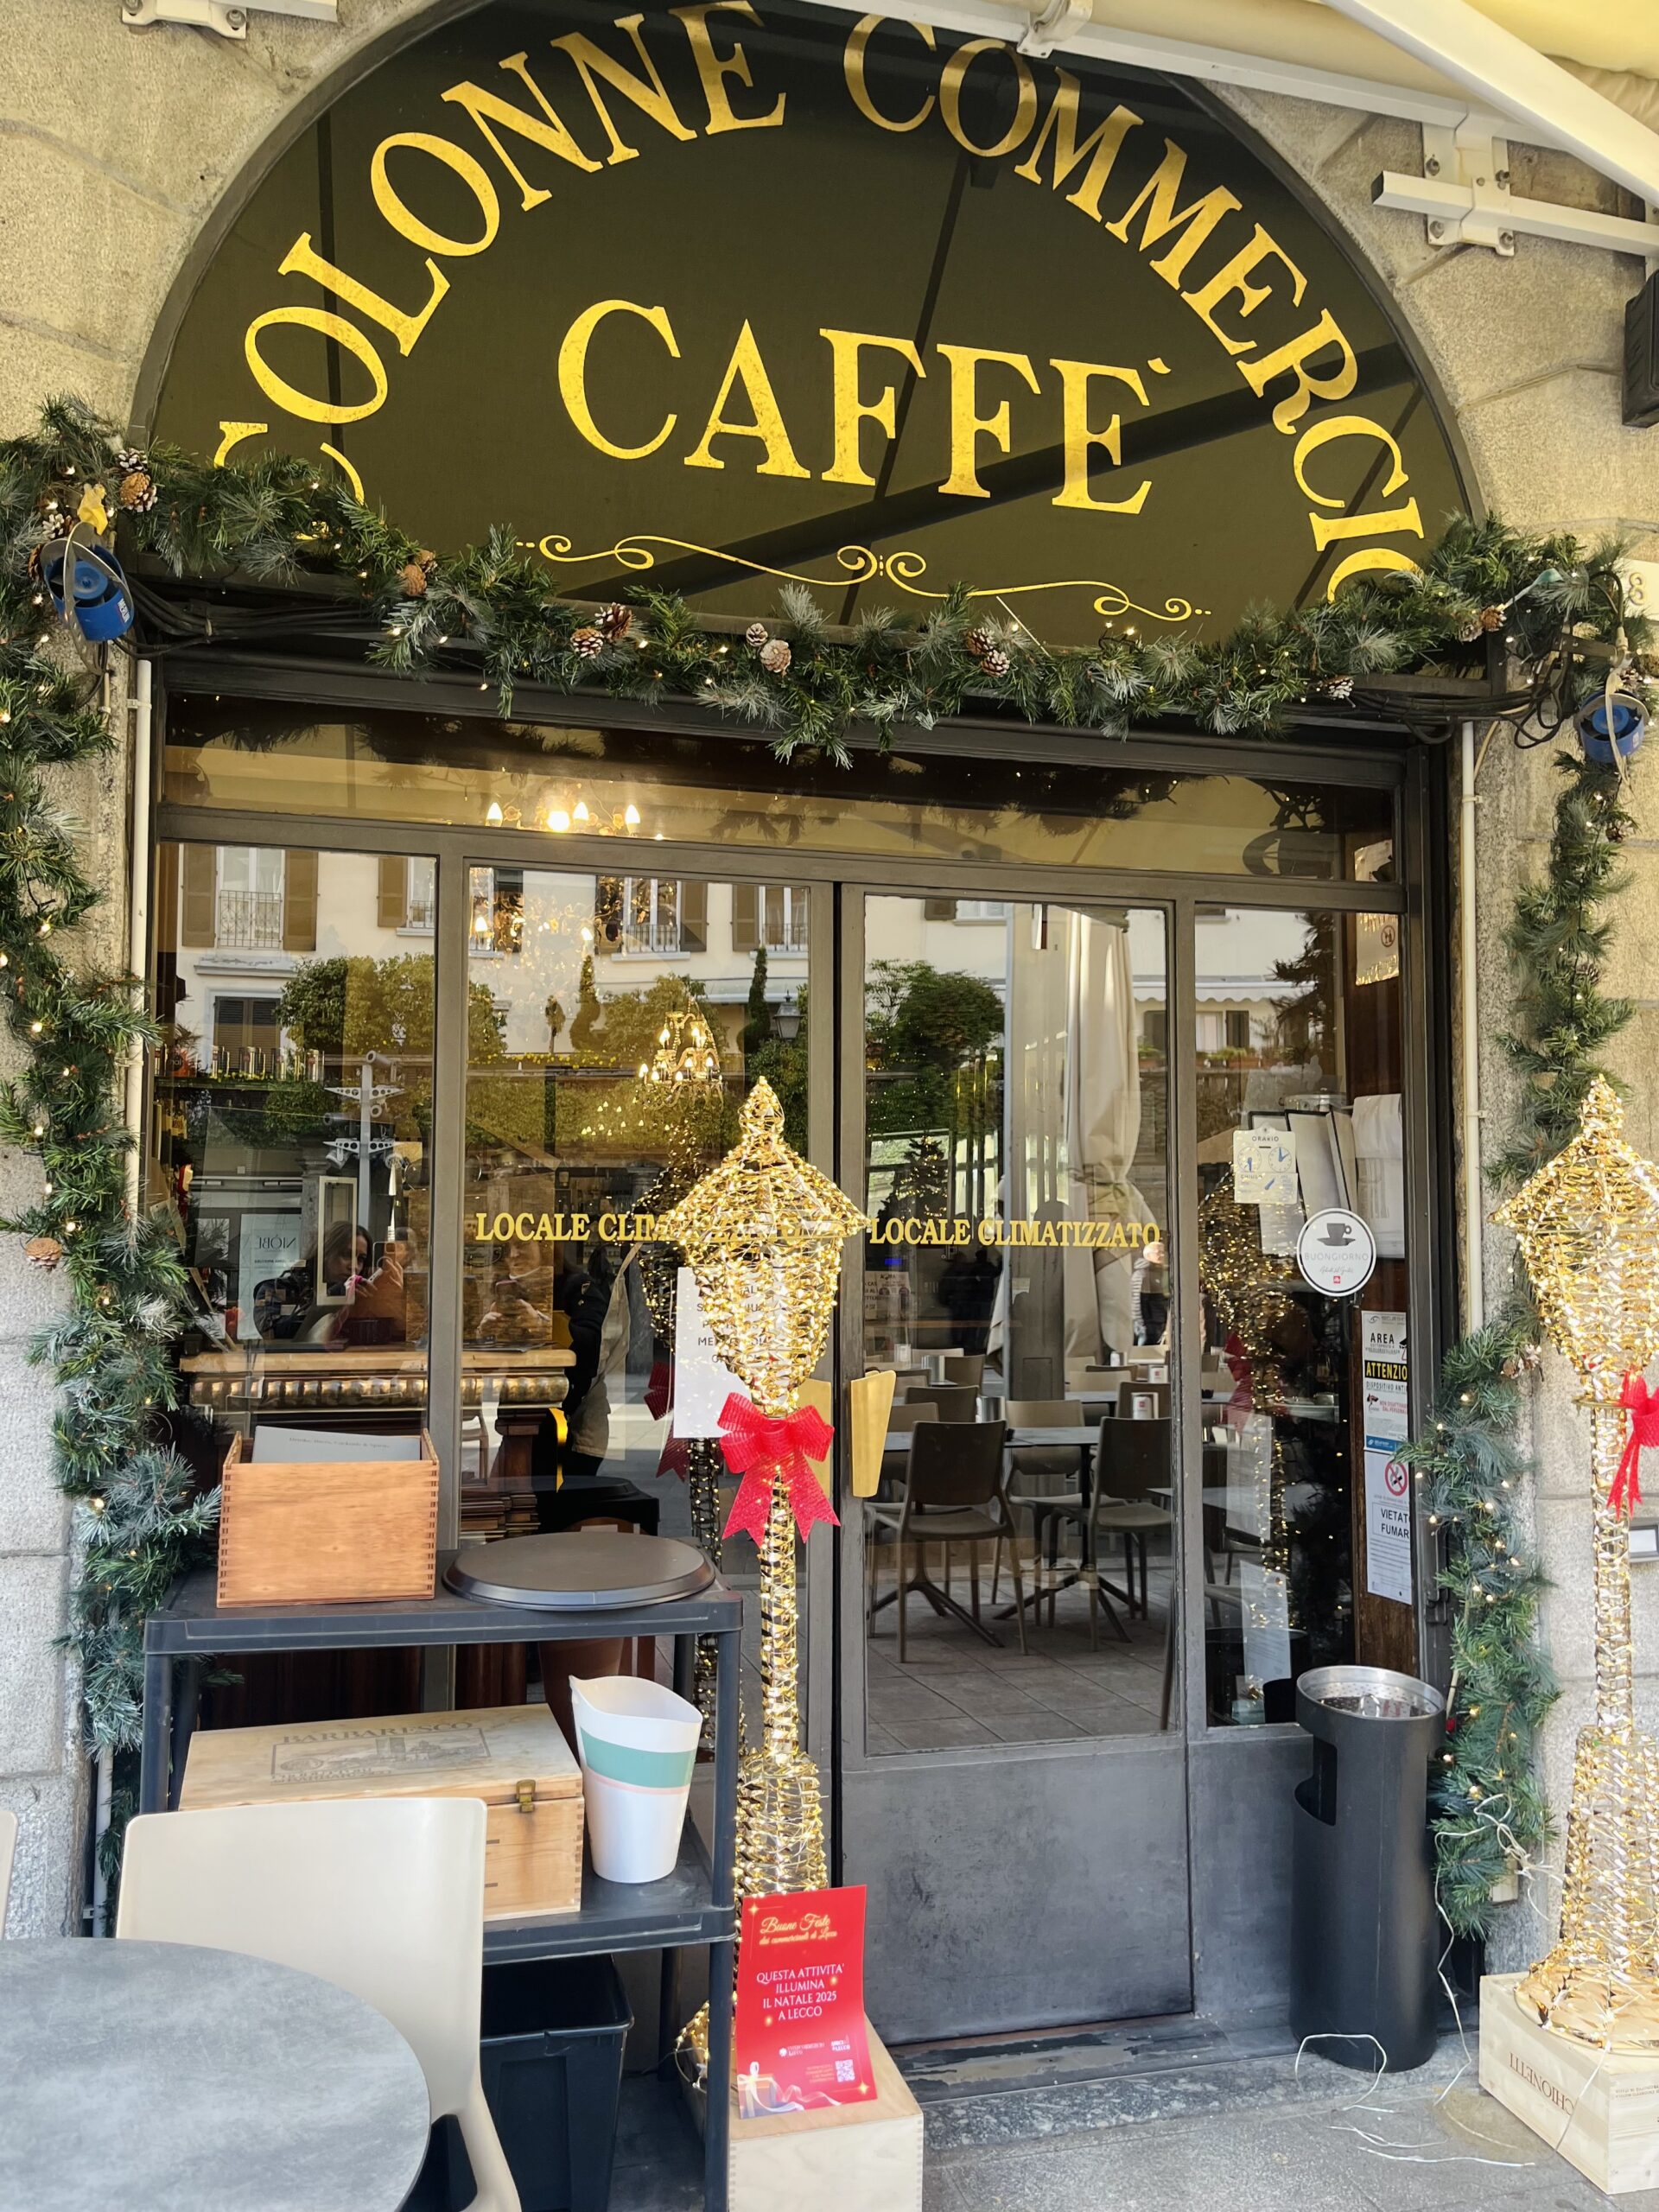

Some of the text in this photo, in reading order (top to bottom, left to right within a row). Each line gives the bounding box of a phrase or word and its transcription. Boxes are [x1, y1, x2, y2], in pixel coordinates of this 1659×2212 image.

[475, 1212, 591, 1242] LOCALE
[869, 1217, 971, 1245] LOCALE
[977, 1219, 1161, 1249] CLIMATIZZATO
[1305, 1252, 1369, 1262] BUONGIORNO
[1370, 1332, 1395, 1344] AREA
[1381, 1509, 1410, 1523] VIETAT
[283, 1721, 474, 1744] BARBARESCO
[760, 1913, 830, 1934] Buone Feste
[756, 1963, 845, 1985] QUESTA ATTIVITA'
[776, 1980, 825, 1995] ILLUMINA
[762, 1990, 837, 2010] IL NATALE 2025
[779, 2007, 823, 2022] A LECCO
[1510, 2052, 1575, 2116] CHIONETTI
